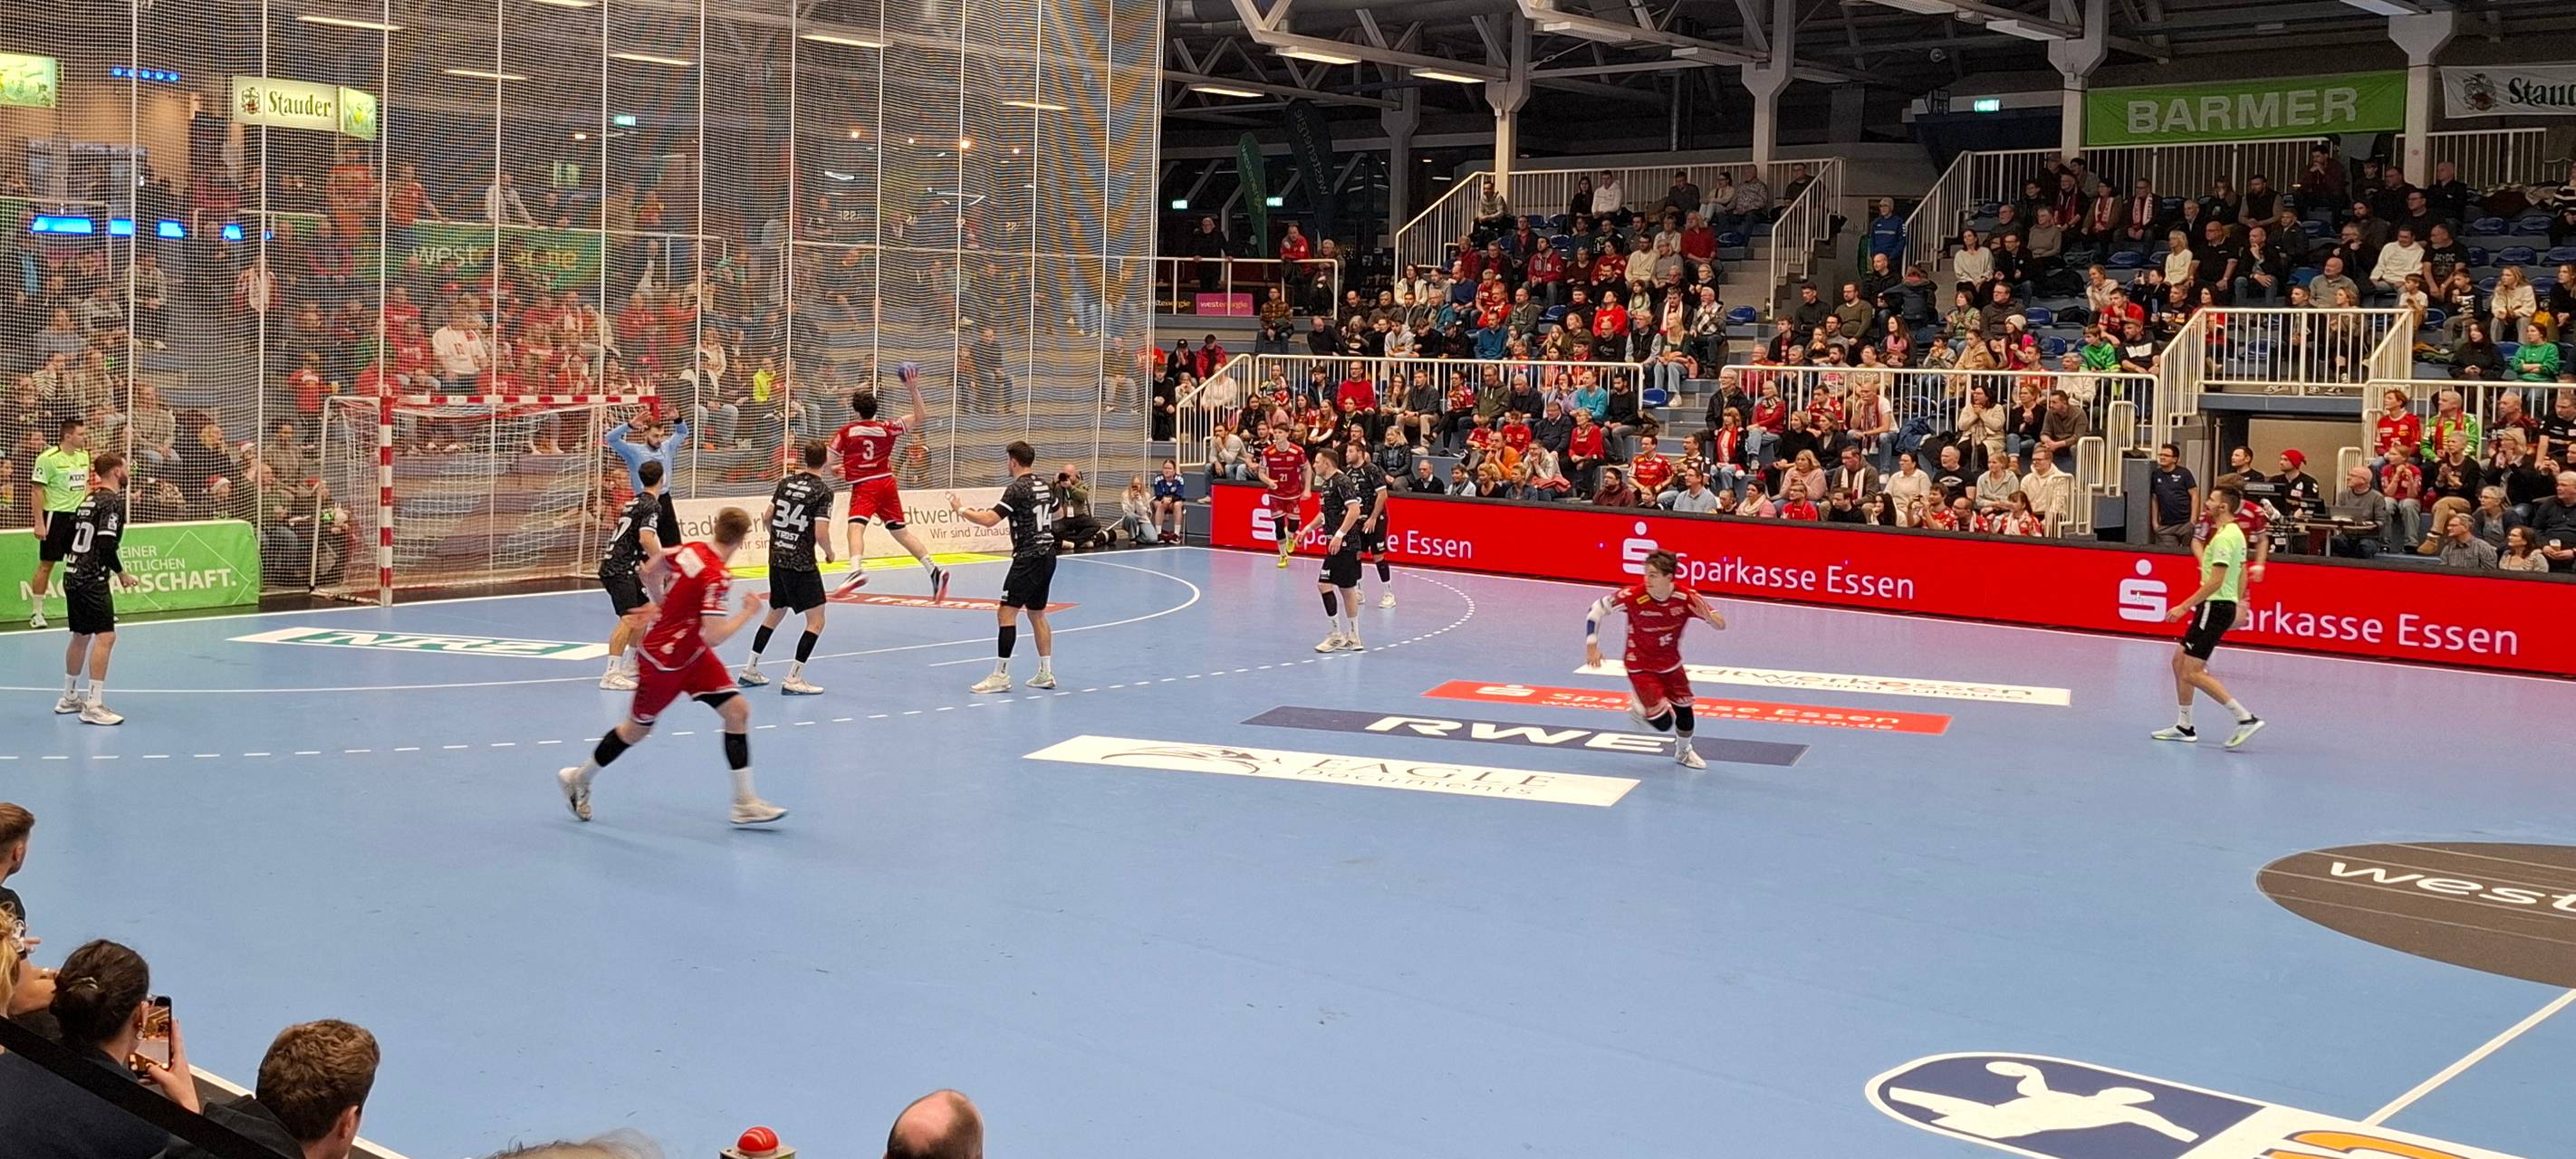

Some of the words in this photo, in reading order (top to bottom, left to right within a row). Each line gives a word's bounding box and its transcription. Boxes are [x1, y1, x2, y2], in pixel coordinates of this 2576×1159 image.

[268, 91, 332, 118] Stauder
[2128, 87, 2359, 134] BARMER
[862, 439, 875, 461] 3
[1279, 473, 1288, 482] 21
[772, 498, 809, 532] 34
[1033, 503, 1052, 532] 14
[930, 528, 947, 541] Wir
[951, 526, 970, 538] sind
[1406, 530, 1472, 559] Essen
[123, 558, 186, 572] RTLICHEN
[1675, 552, 1817, 591] Sparkasse
[1826, 565, 1915, 600] Essen
[2187, 601, 2384, 644] arkasse
[2398, 612, 2518, 656] Essen
[1687, 668, 2033, 695] dtwerkessen
[1548, 693, 1760, 714] Spasse
[1773, 709, 1899, 724] Essen
[1364, 716, 1676, 753] RWE
[1296, 769, 1535, 795] Documents
[1310, 759, 1556, 787] EAGLE
[2330, 861, 2576, 913] west
